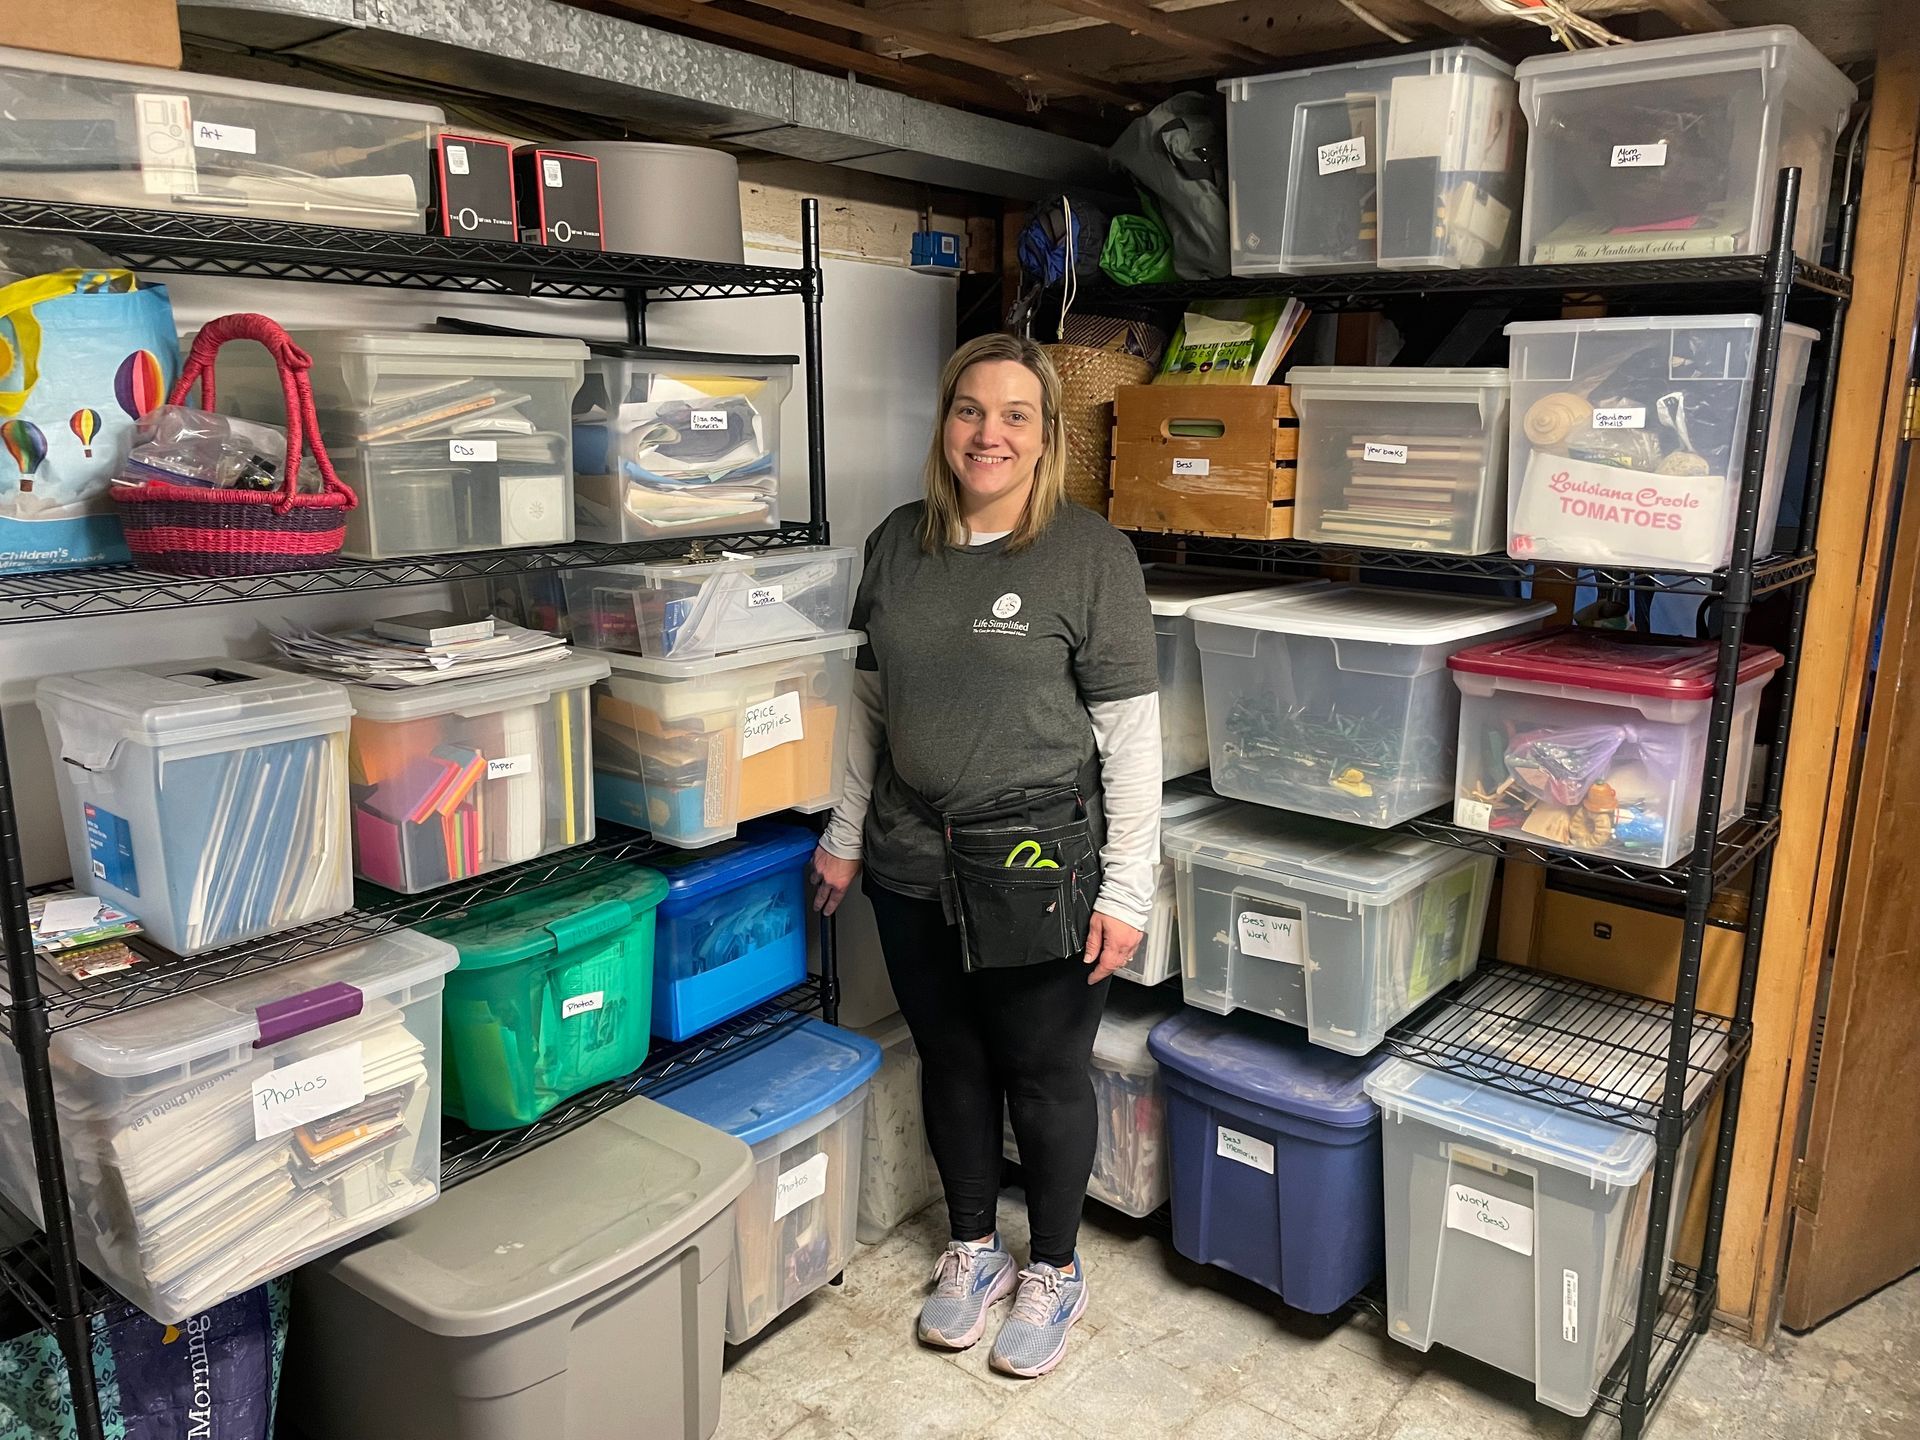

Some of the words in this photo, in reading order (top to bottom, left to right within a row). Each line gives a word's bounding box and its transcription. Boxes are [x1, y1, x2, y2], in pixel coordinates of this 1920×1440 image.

[200, 126, 222, 140] Art
[1191, 348, 1236, 358] DESIGN
[1176, 460, 1193, 468] Bess
[1549, 471, 1633, 502] Louisiana
[1635, 487, 1700, 509] Creole
[1559, 496, 1683, 531] TOMATOES
[0, 546, 69, 561] Children's
[973, 619, 988, 628] Life
[988, 619, 1030, 632] Simplified
[1241, 914, 1265, 927] Bess
[566, 1000, 595, 1012] Photos
[254, 1073, 328, 1110] Photos
[153, 1093, 188, 1118] Photo
[1456, 1191, 1490, 1211] Work
[1476, 1210, 1510, 1230] (Bess)
[186, 1314, 211, 1440] Morning
